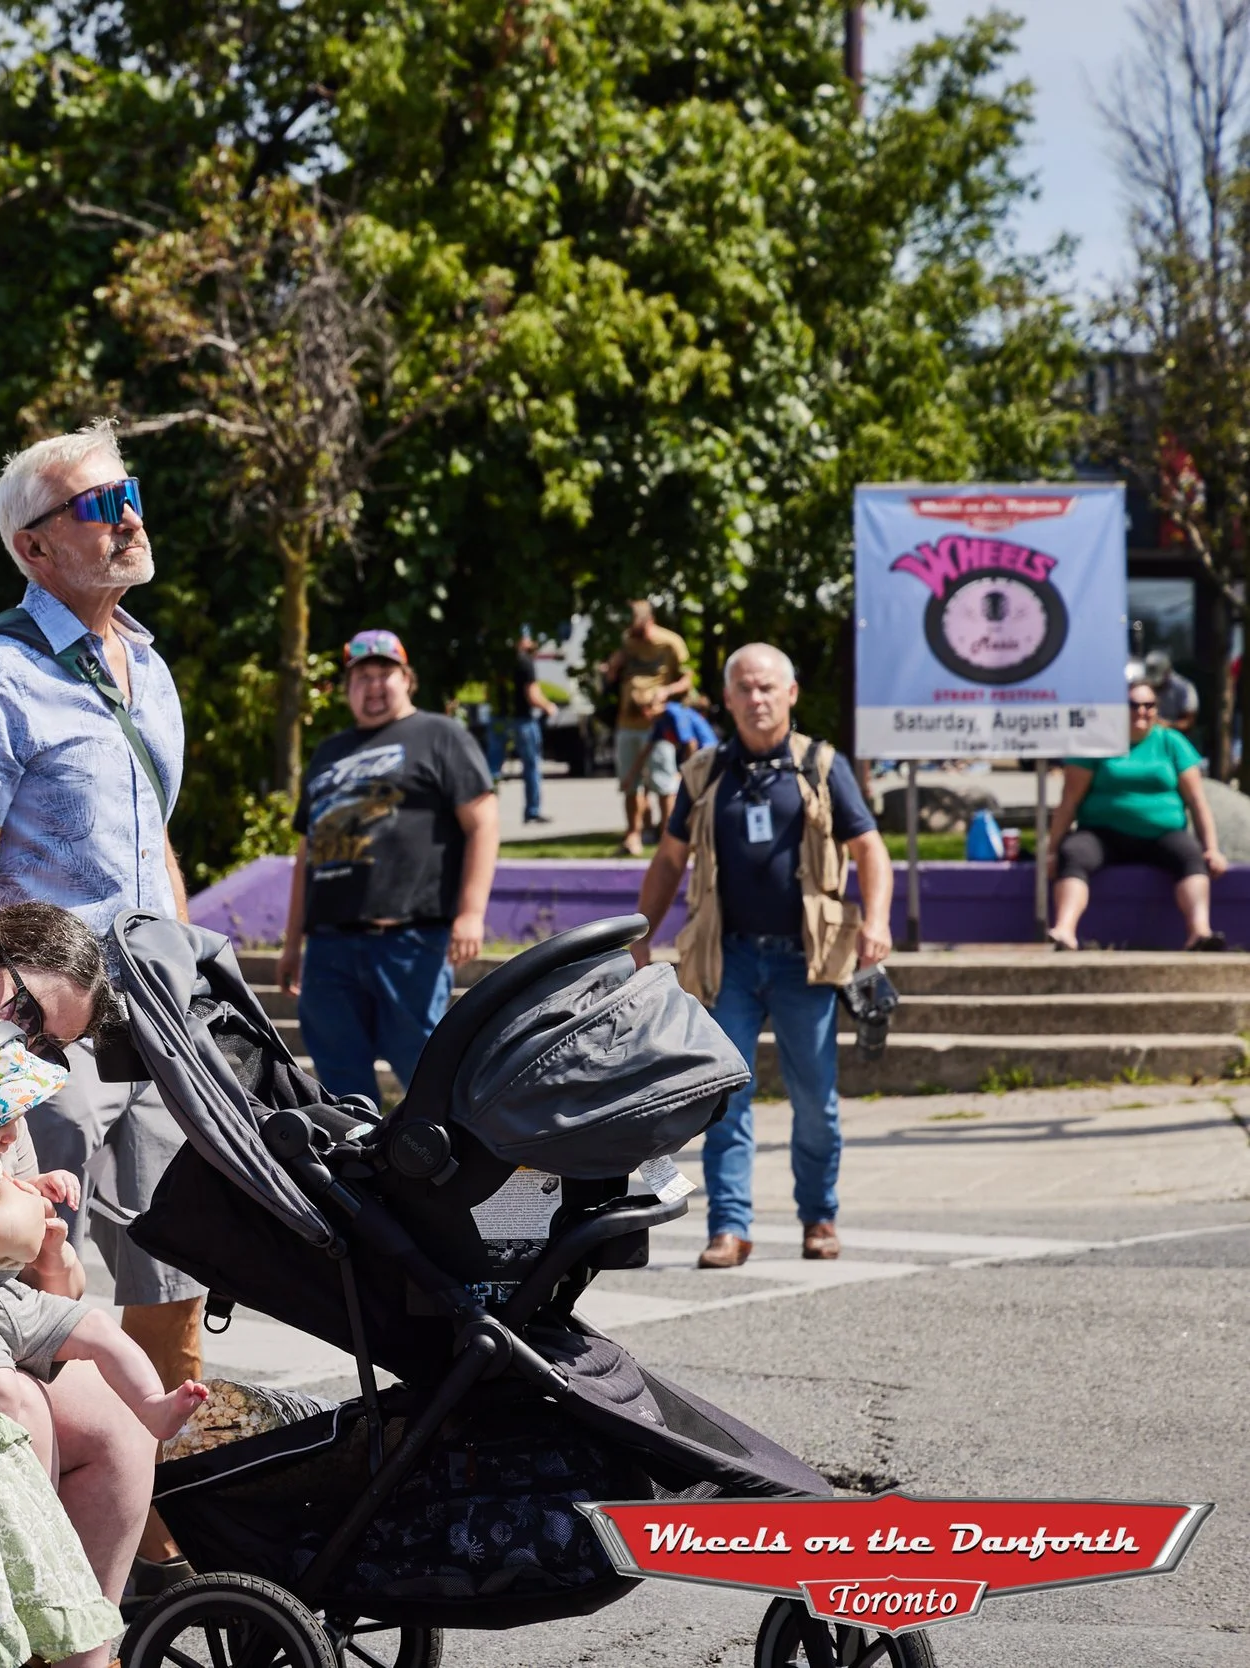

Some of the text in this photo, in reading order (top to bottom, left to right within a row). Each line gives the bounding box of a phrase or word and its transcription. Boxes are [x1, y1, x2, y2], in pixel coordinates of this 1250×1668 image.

[891, 533, 1058, 598] WHEELS
[933, 688, 1058, 702] STREET FESTIVAL
[893, 709, 980, 734] Saturday,
[992, 709, 1059, 735] August
